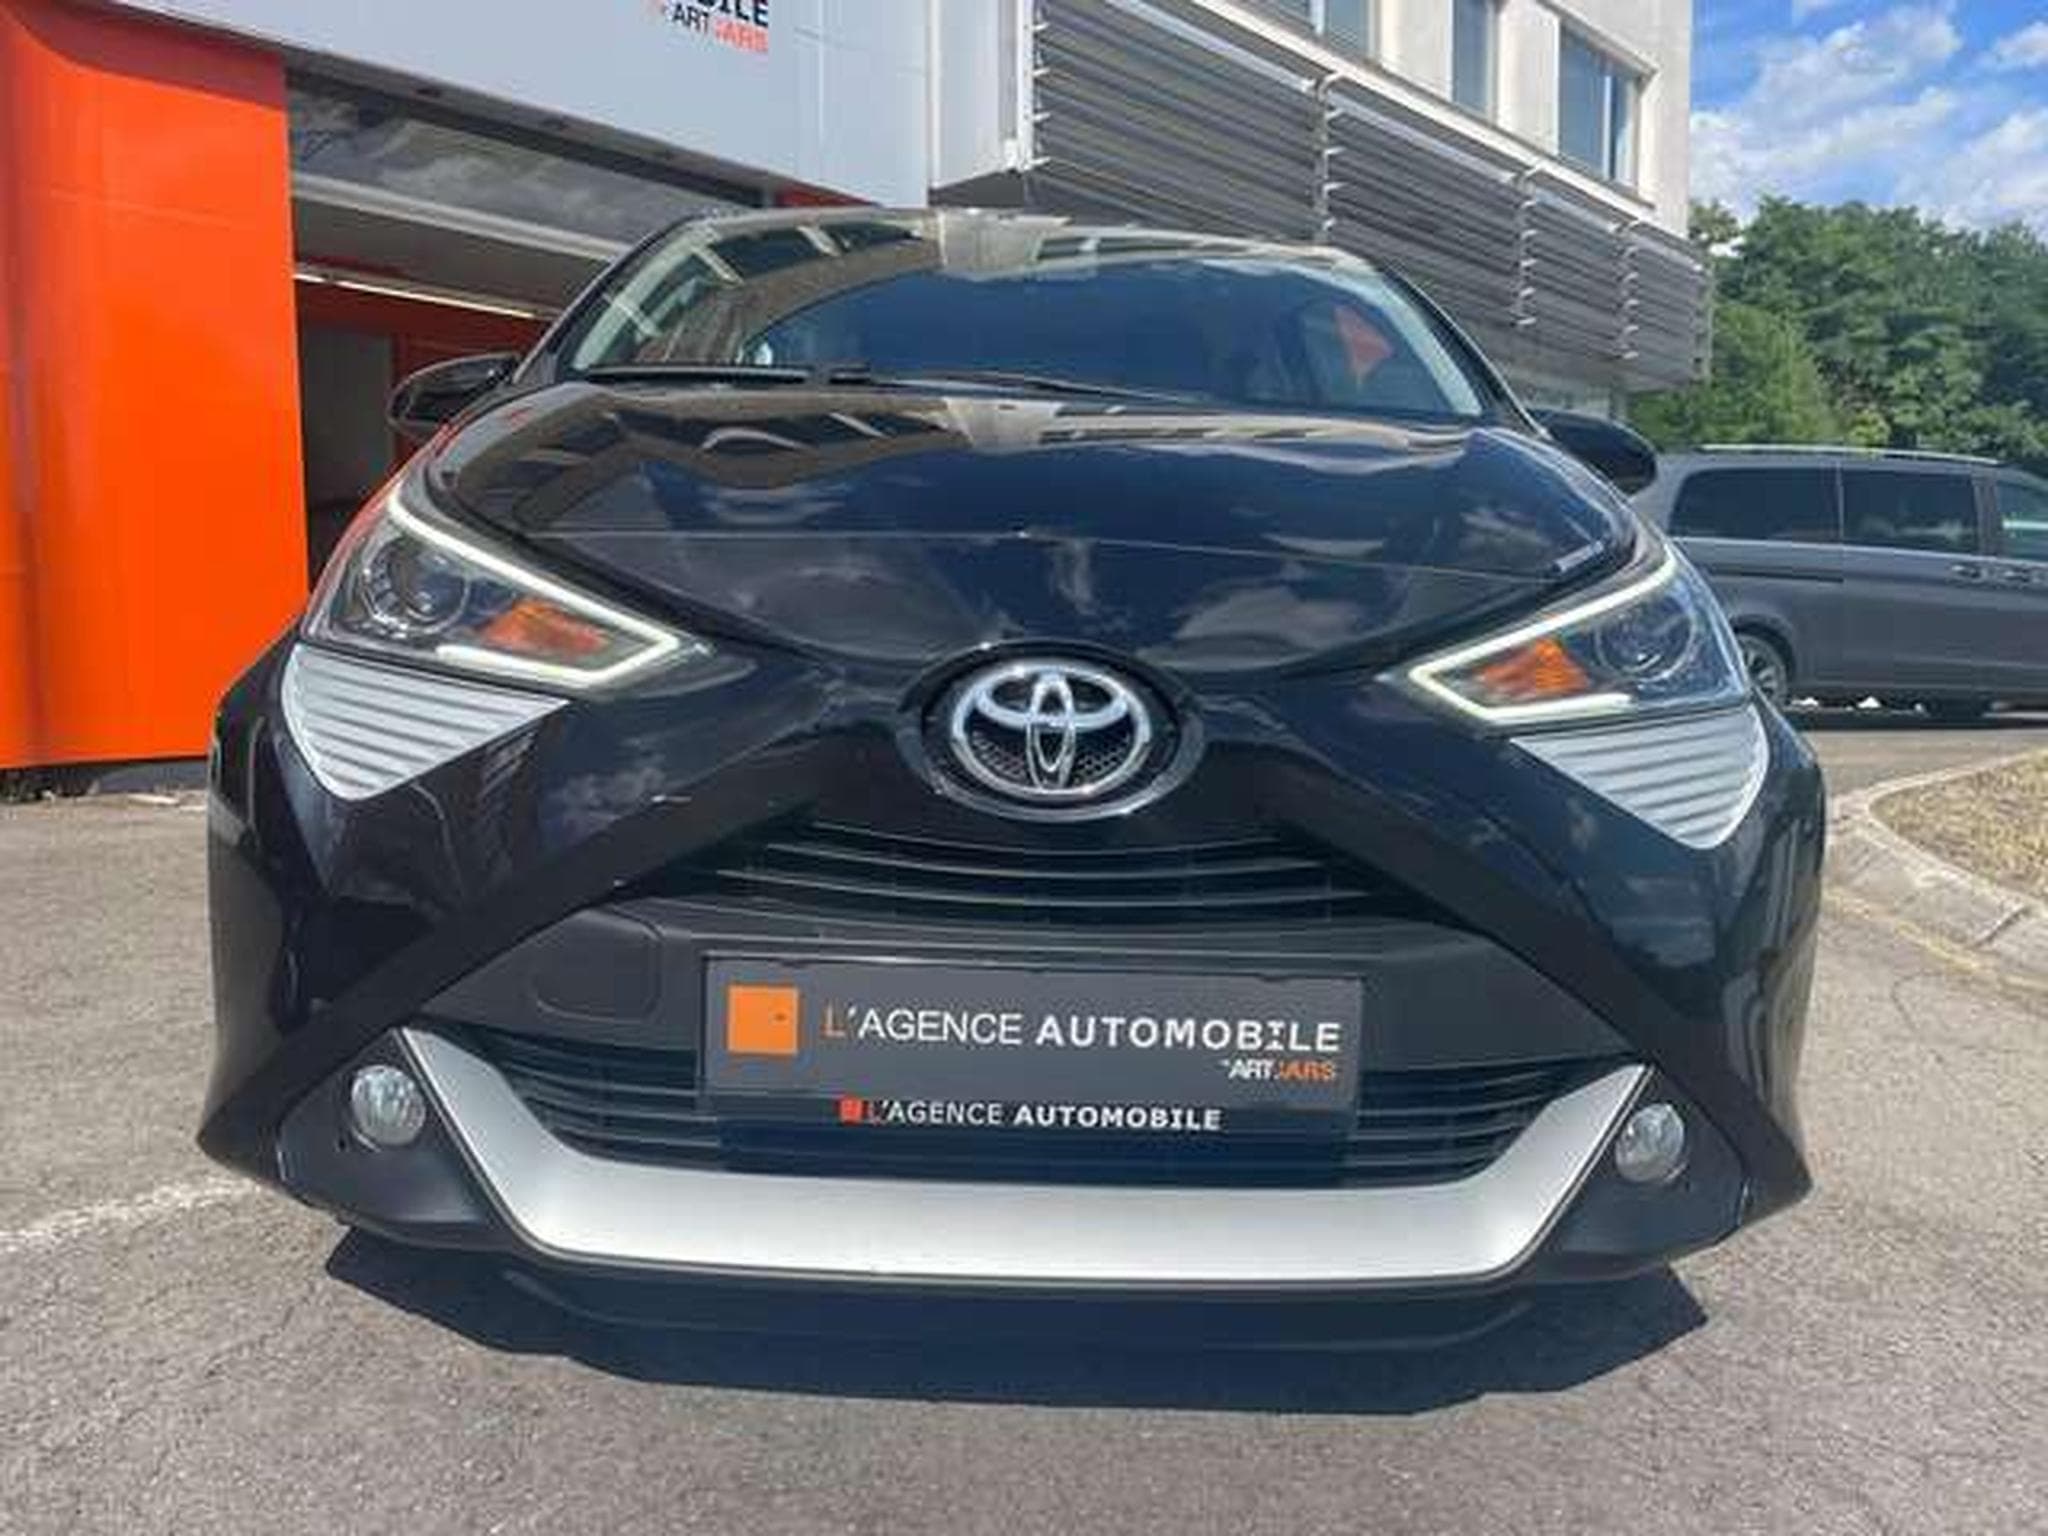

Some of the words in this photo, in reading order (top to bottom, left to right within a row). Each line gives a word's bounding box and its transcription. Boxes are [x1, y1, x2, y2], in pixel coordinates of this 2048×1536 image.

[824, 1002, 1023, 1045] L'AGENCE
[1035, 1015, 1341, 1052] AUTOMOBILE
[1014, 1104, 1222, 1131] AUTOMOBILE
